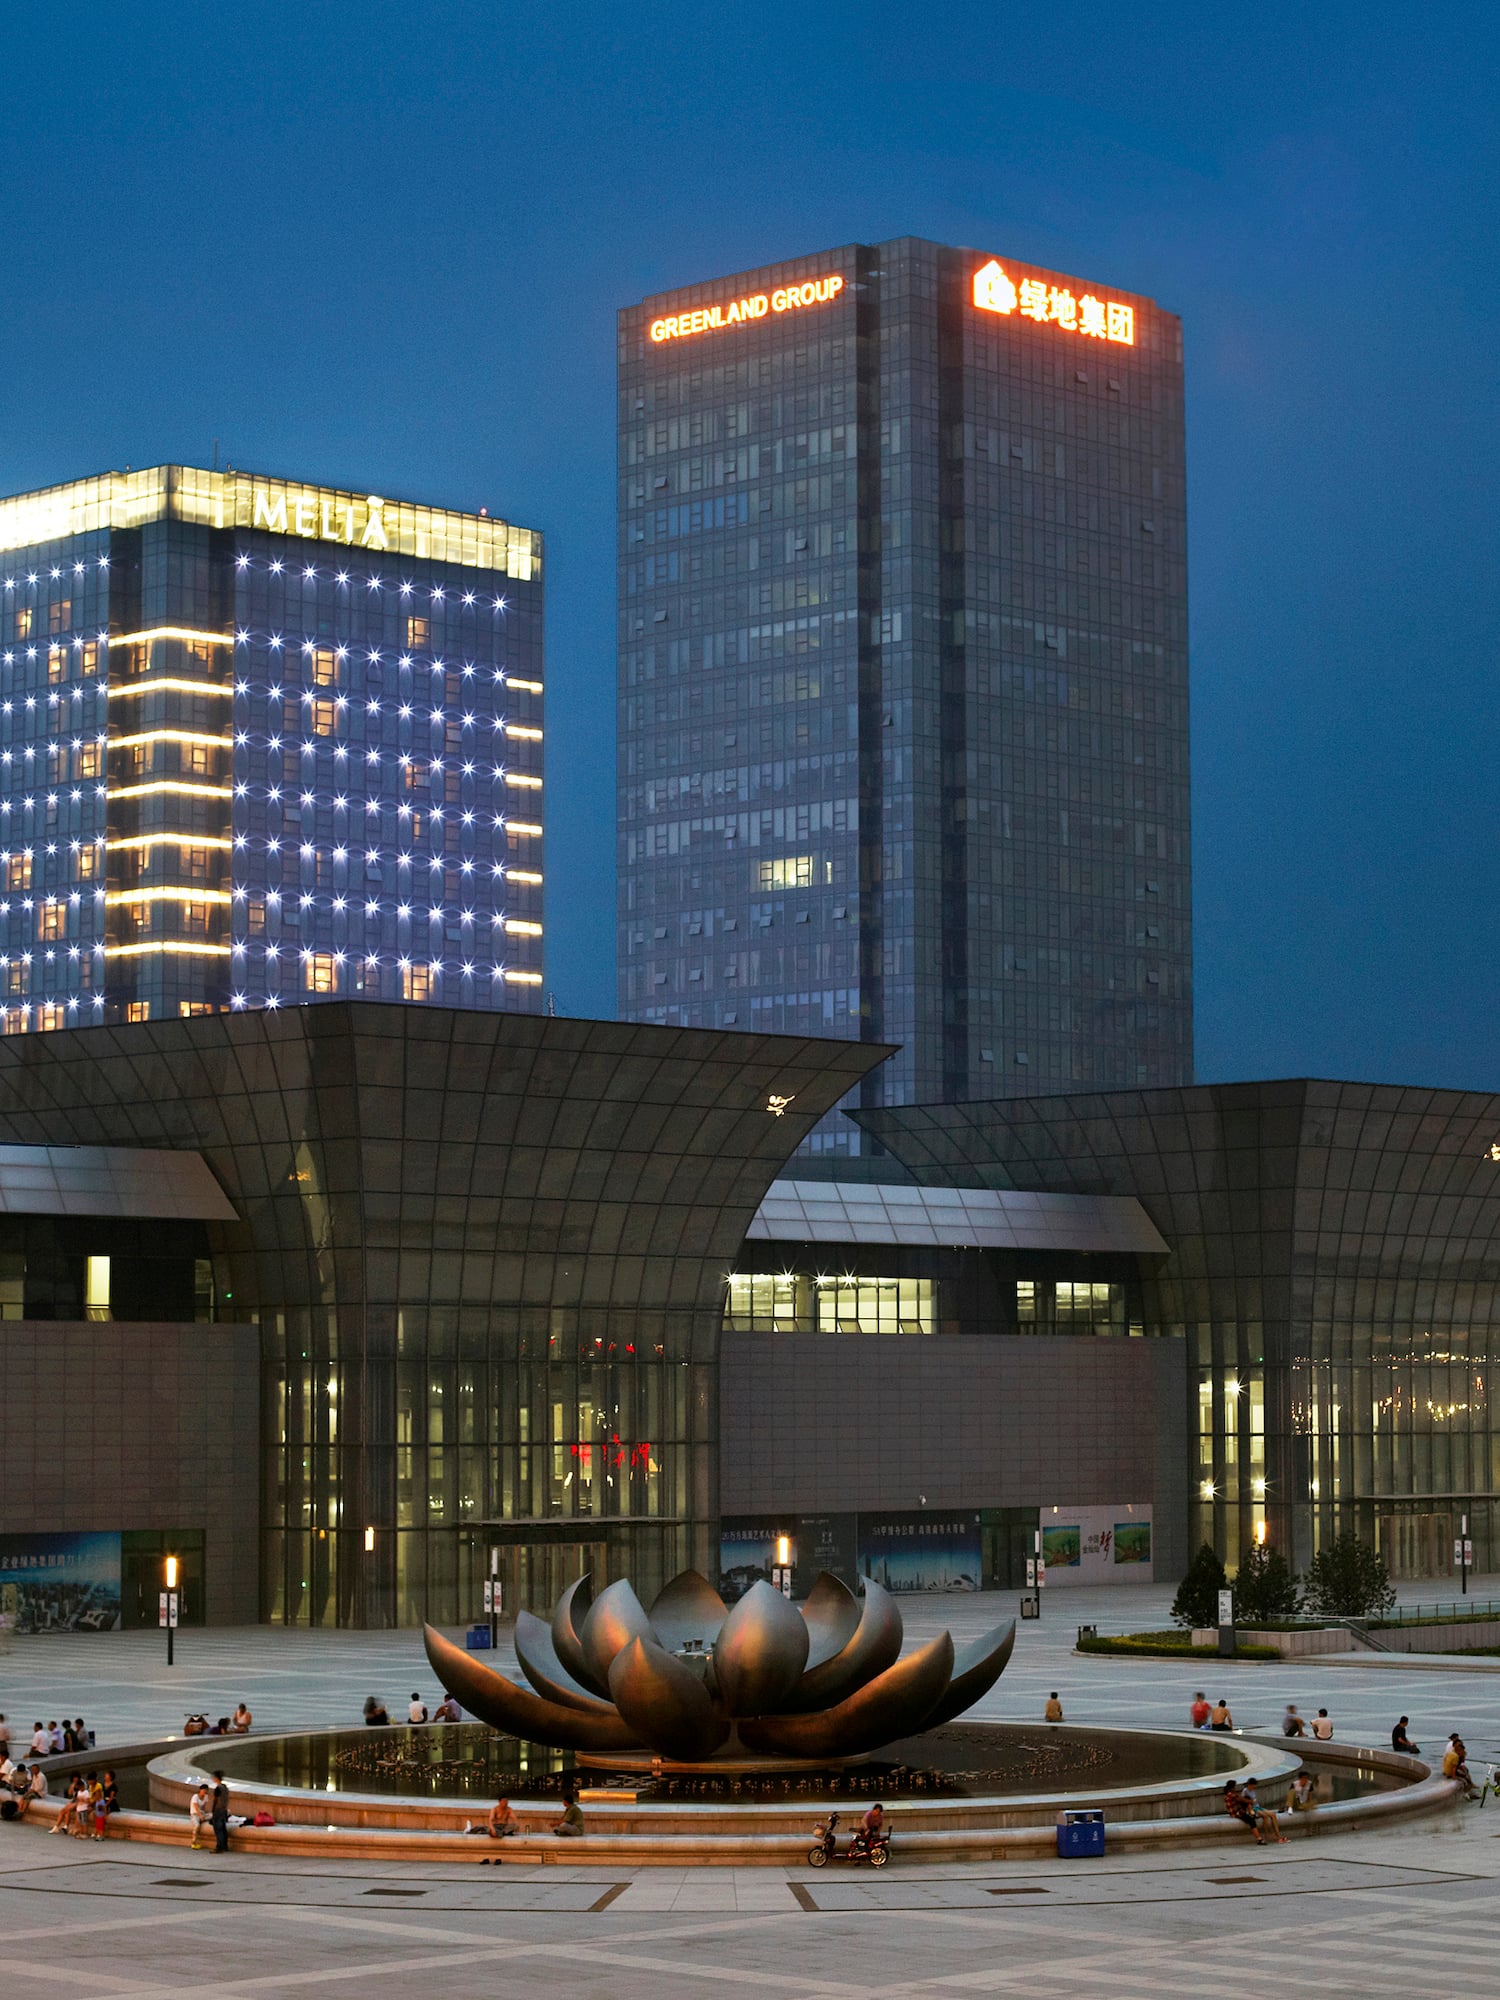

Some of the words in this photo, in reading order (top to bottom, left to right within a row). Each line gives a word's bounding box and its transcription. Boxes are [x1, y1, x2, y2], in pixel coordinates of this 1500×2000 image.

[651, 296, 768, 342] GREENLAND
[772, 276, 843, 312] GROUP
[1019, 278, 1134, 346] 绿地集团
